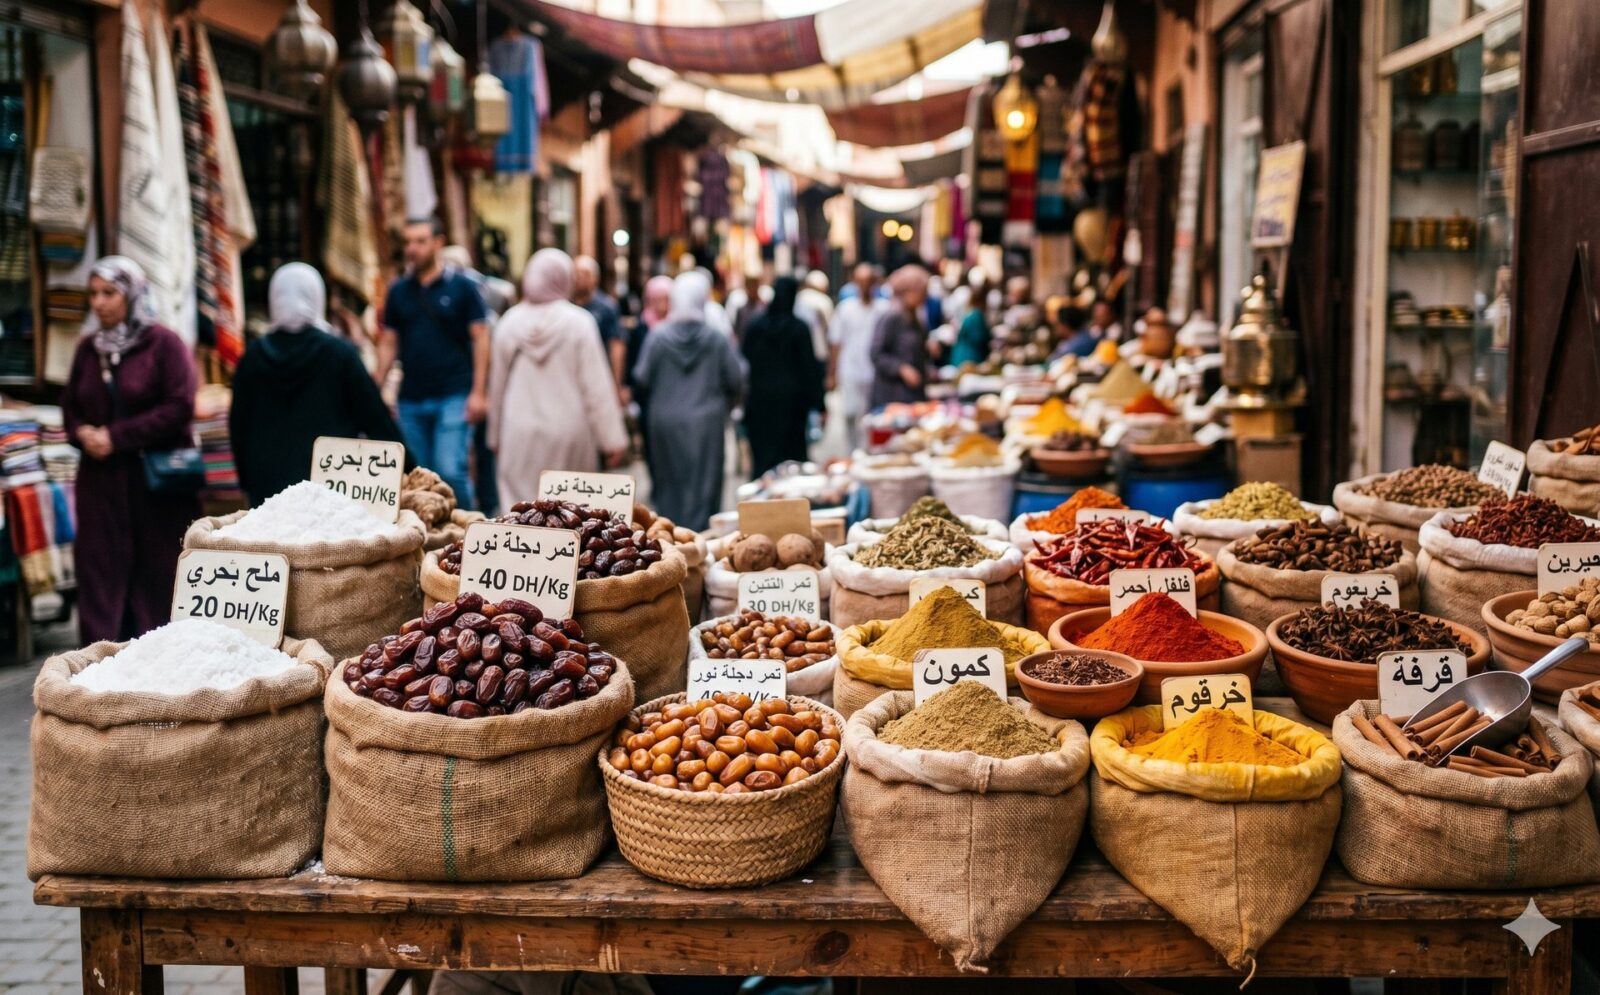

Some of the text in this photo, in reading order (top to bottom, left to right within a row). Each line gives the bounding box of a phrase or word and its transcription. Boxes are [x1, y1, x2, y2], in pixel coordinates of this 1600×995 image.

[319, 449, 397, 477] ملح بحري
[352, 485, 397, 507] DH/Kg
[545, 478, 631, 499] تمر دجلة نور
[468, 531, 575, 561] تمر دجلة نور
[246, 560, 280, 593] ملح
[478, 568, 507, 591] 40
[512, 575, 570, 600] DH/Kg
[789, 576, 812, 593] تمر
[1115, 574, 1191, 599] فلفل أحمر
[189, 595, 219, 618] 20
[223, 601, 280, 627] DH/Kg
[771, 599, 815, 615] DH/Kg
[693, 664, 782, 683] تمر دجلة نور
[923, 654, 991, 685] كمون
[1392, 655, 1454, 693] قرفة
[1171, 678, 1247, 719] خرقوم
